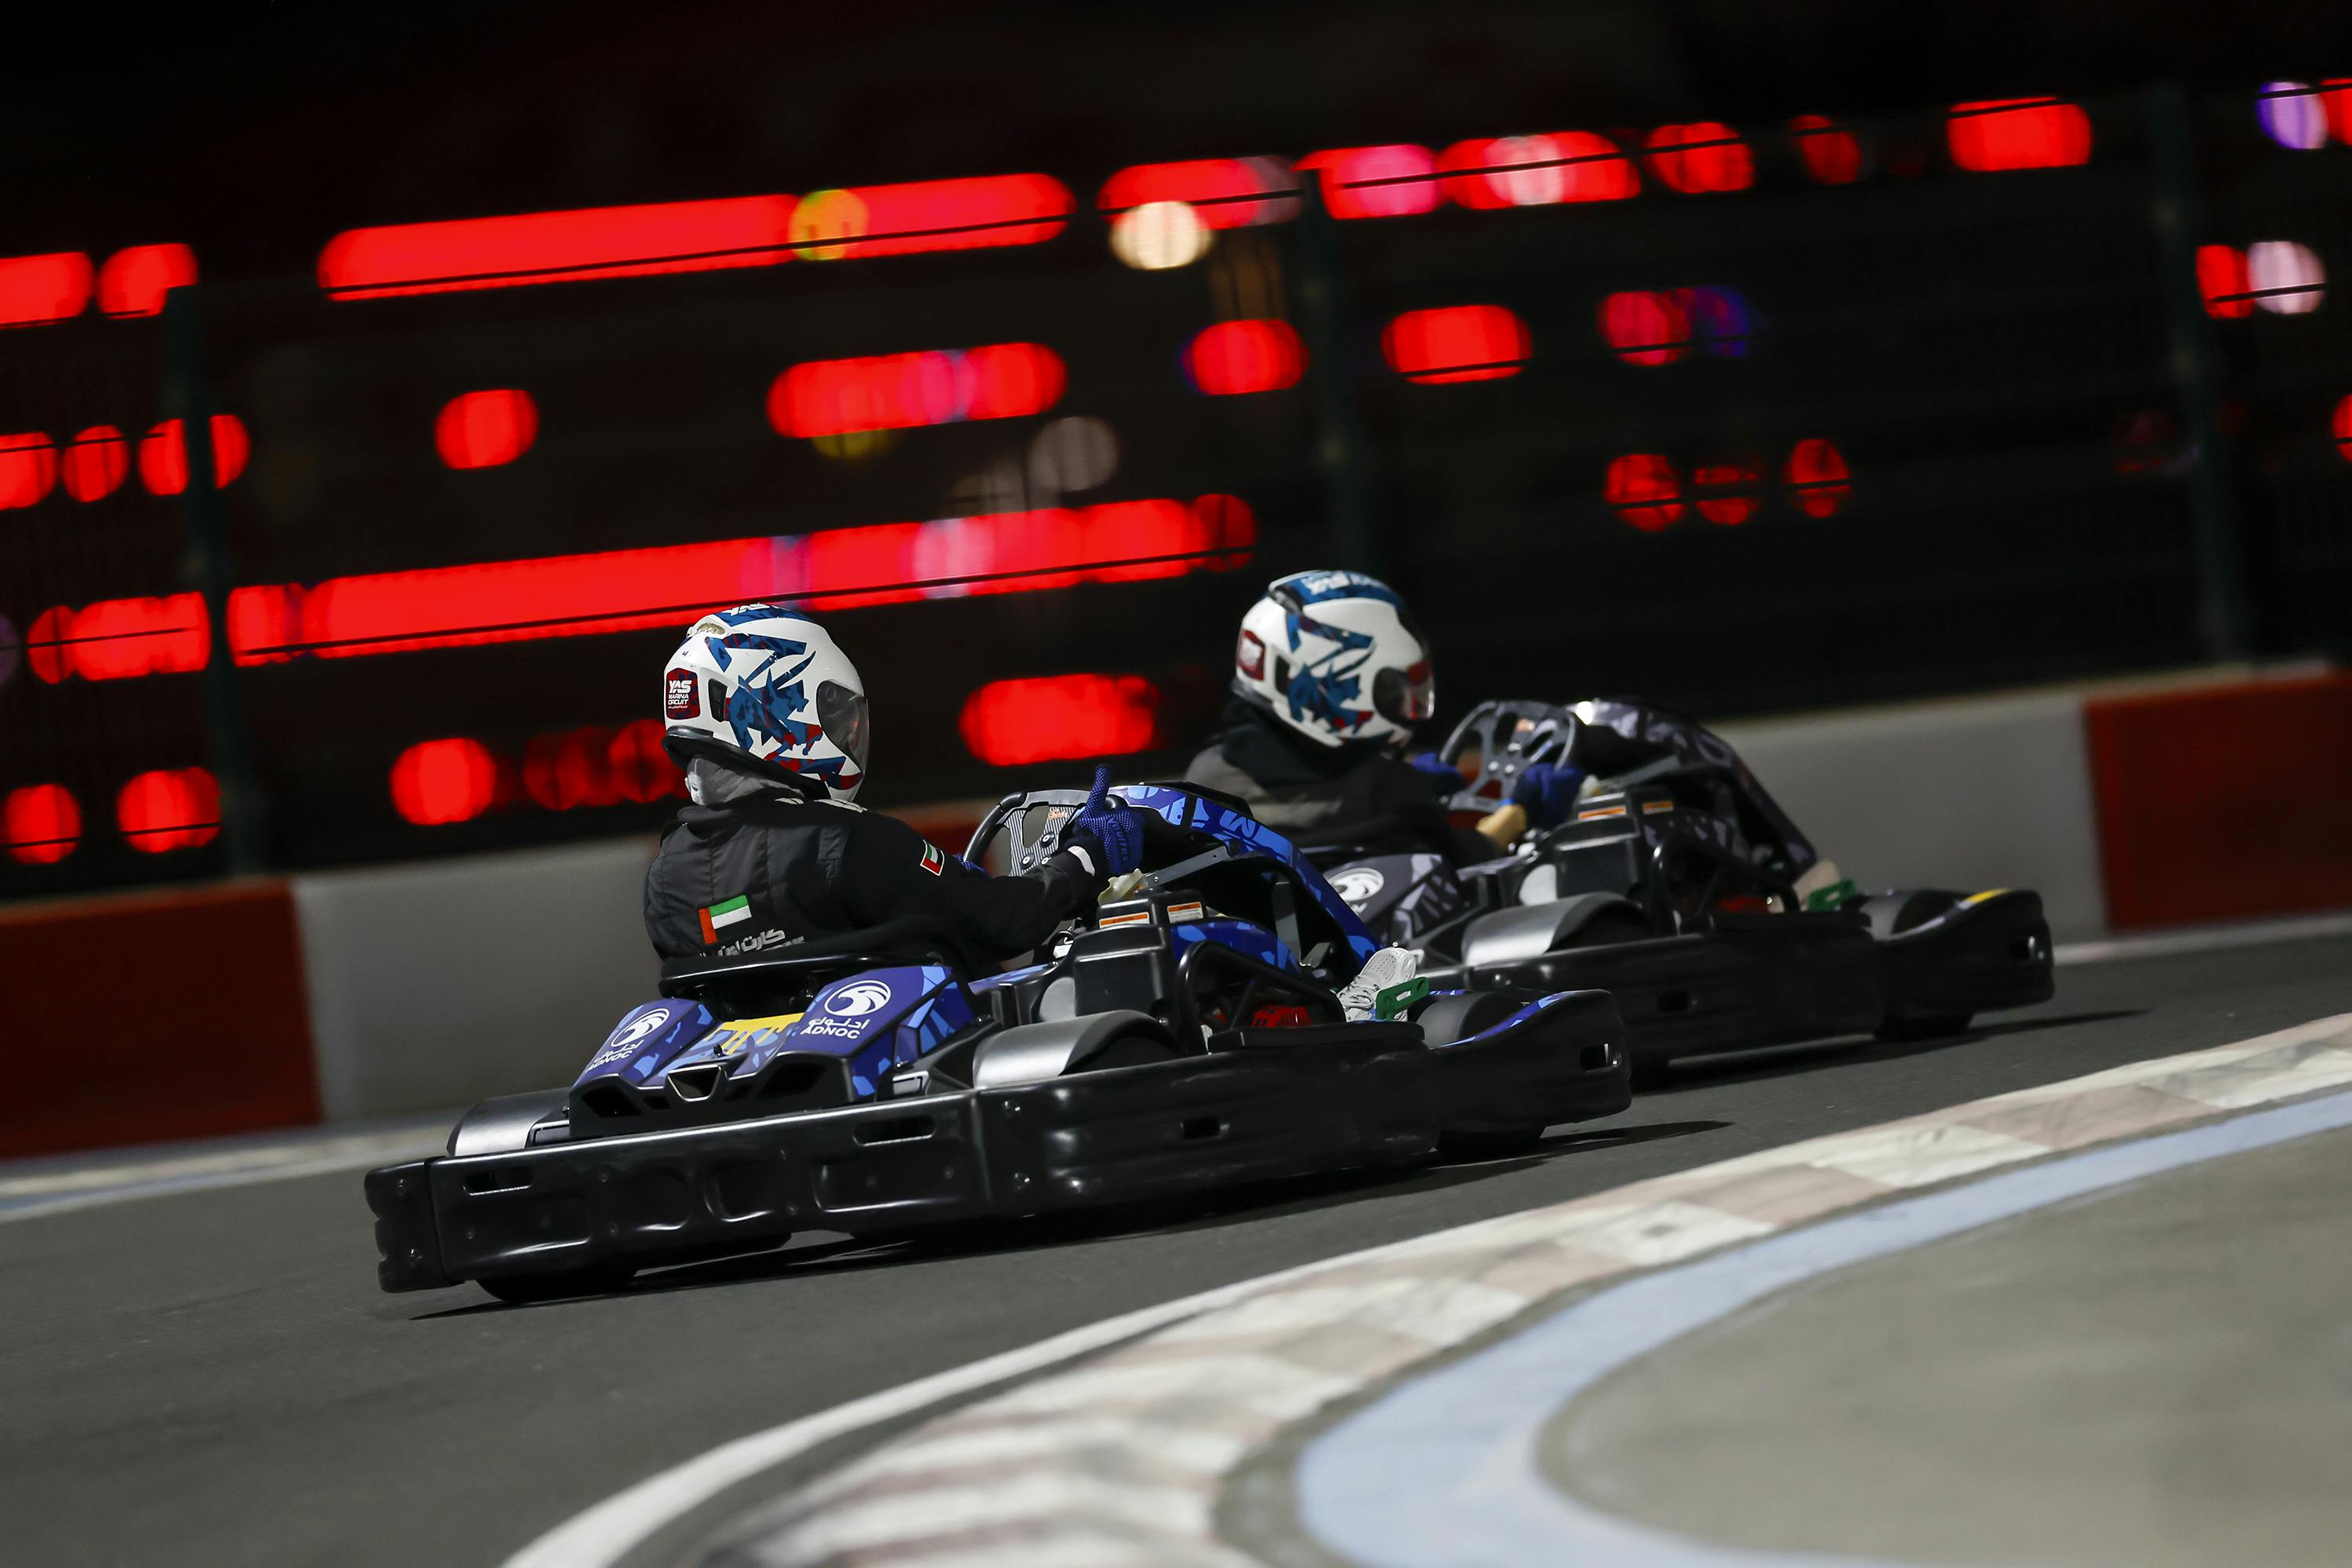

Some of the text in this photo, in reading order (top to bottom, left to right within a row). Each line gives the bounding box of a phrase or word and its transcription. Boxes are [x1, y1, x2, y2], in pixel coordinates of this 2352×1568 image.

[669, 680, 692, 694] YAS
[800, 1025, 860, 1040] ADNOC
[585, 1050, 633, 1073] ADNOC
